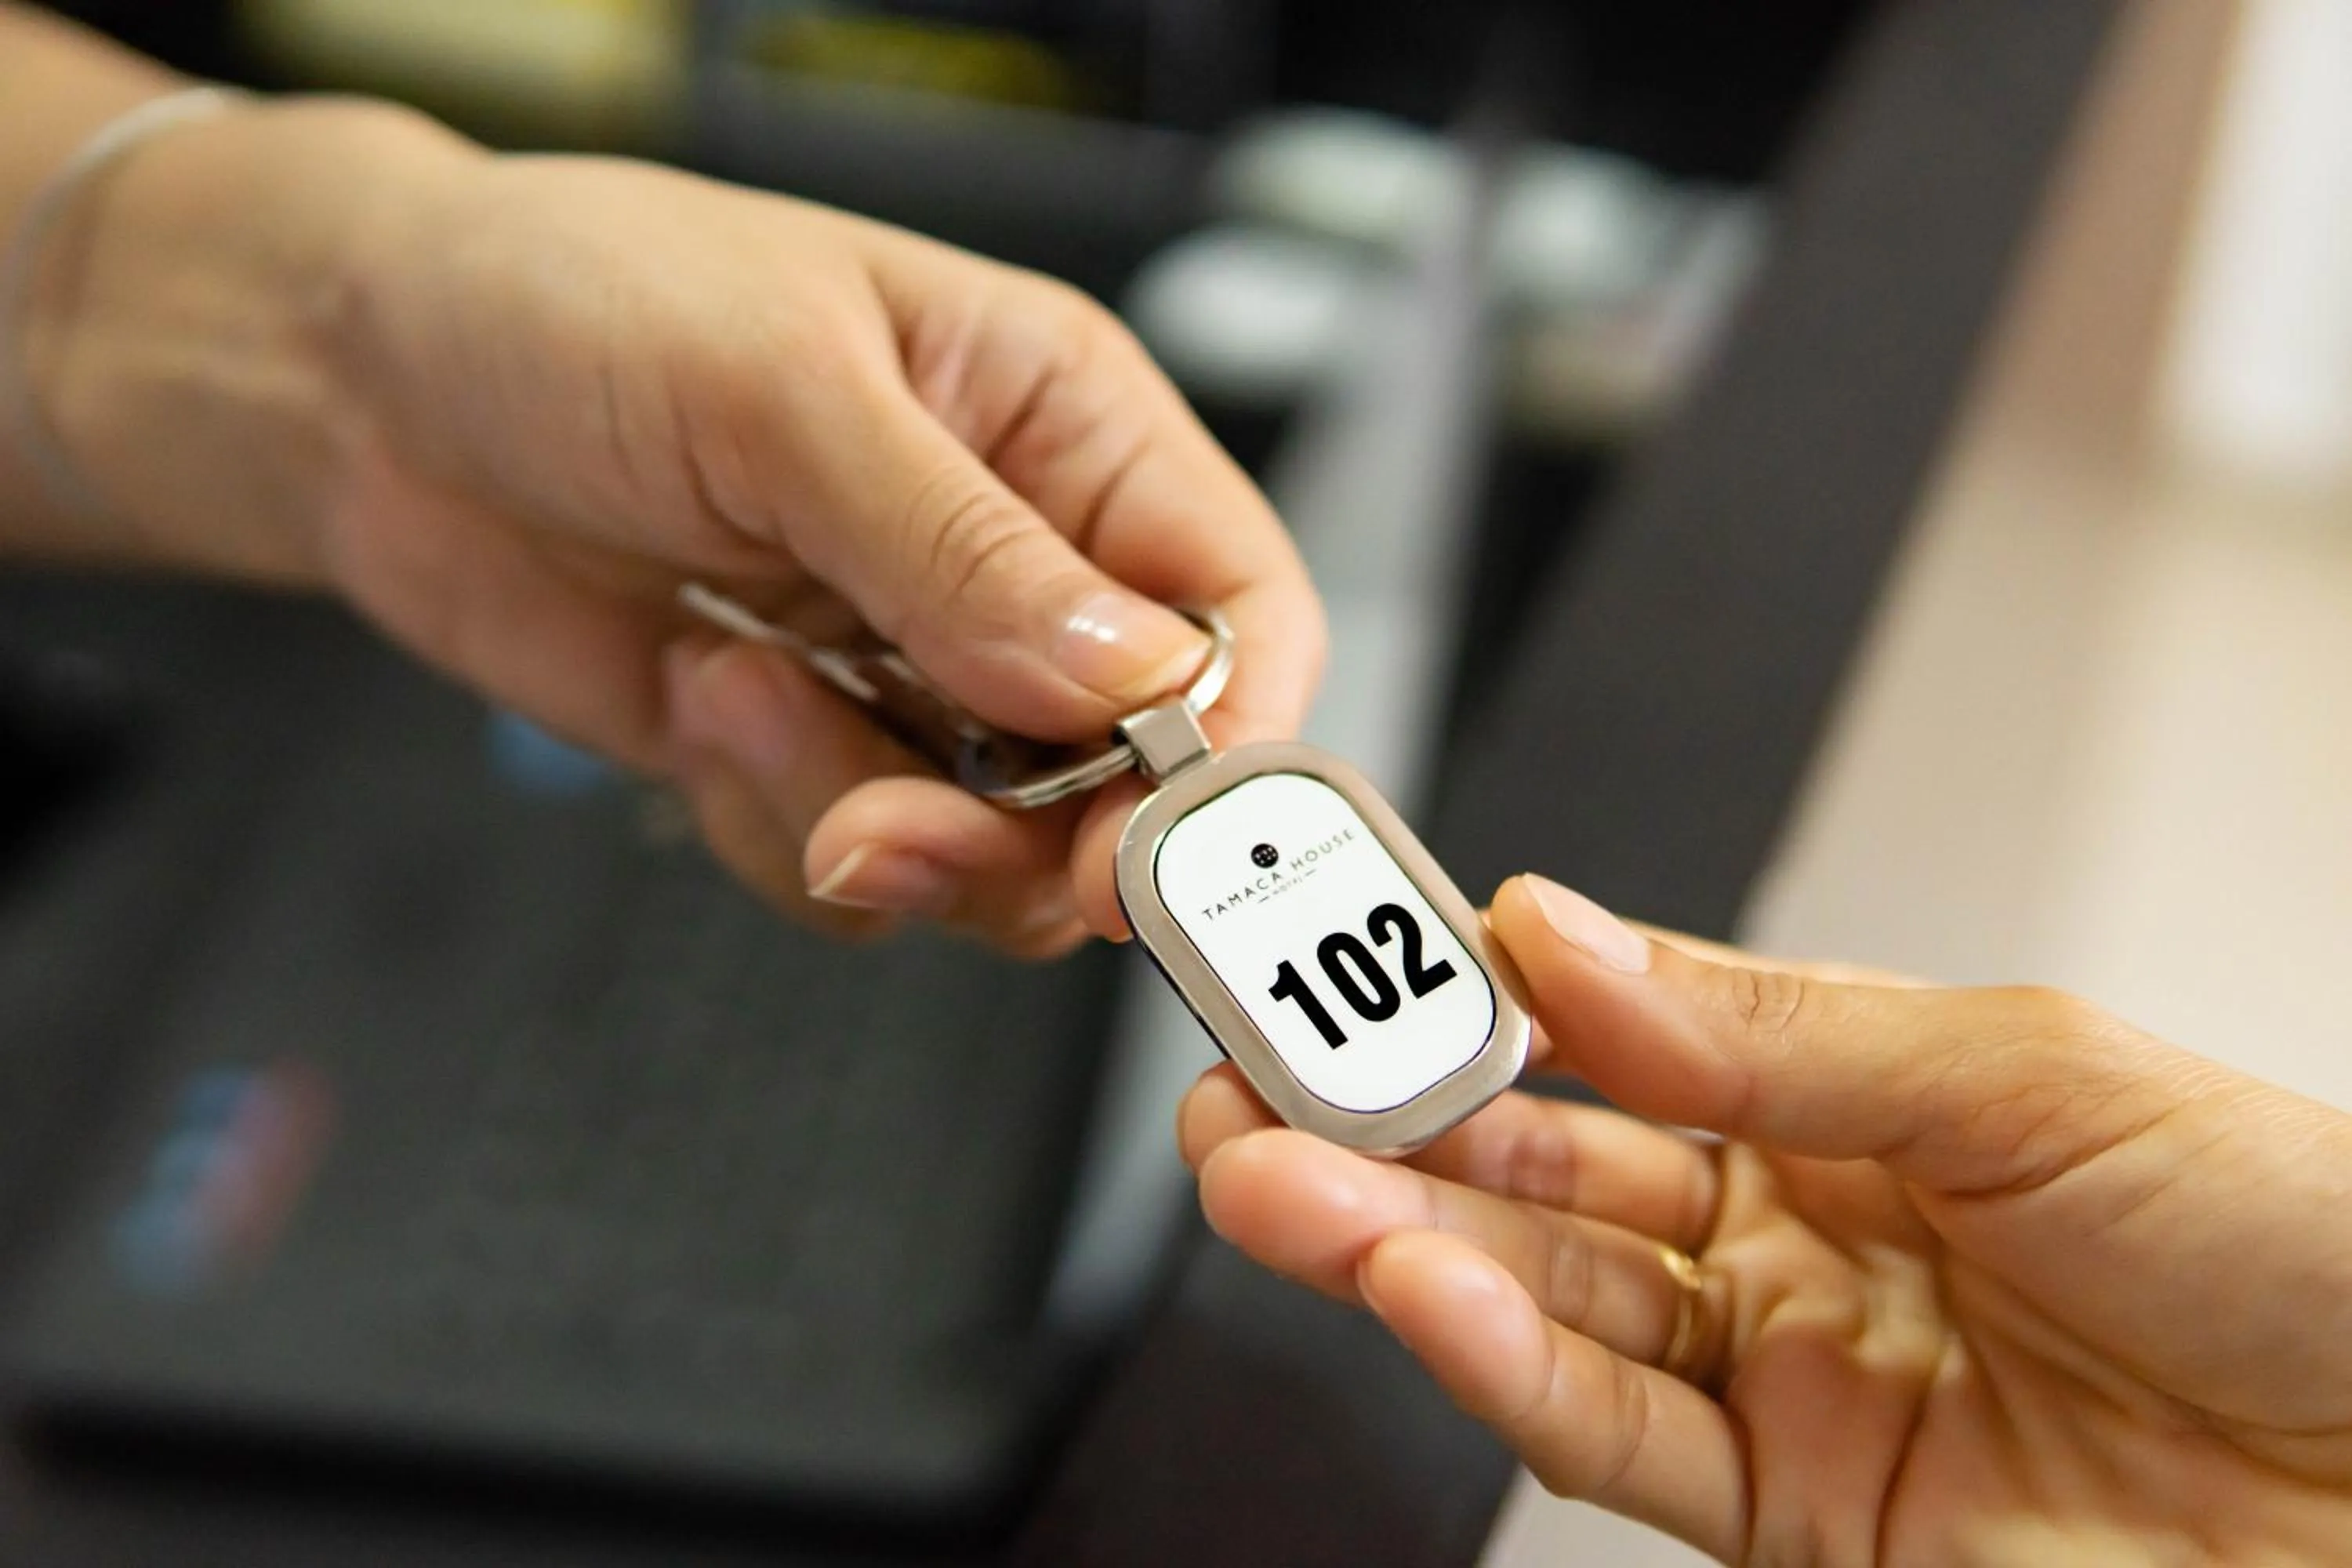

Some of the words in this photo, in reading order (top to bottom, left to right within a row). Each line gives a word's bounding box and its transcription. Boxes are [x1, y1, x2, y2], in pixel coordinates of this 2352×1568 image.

[1202, 872, 1282, 920] TAMACA
[1290, 829, 1355, 870] HOUSE
[1269, 903, 1457, 1049] 102
